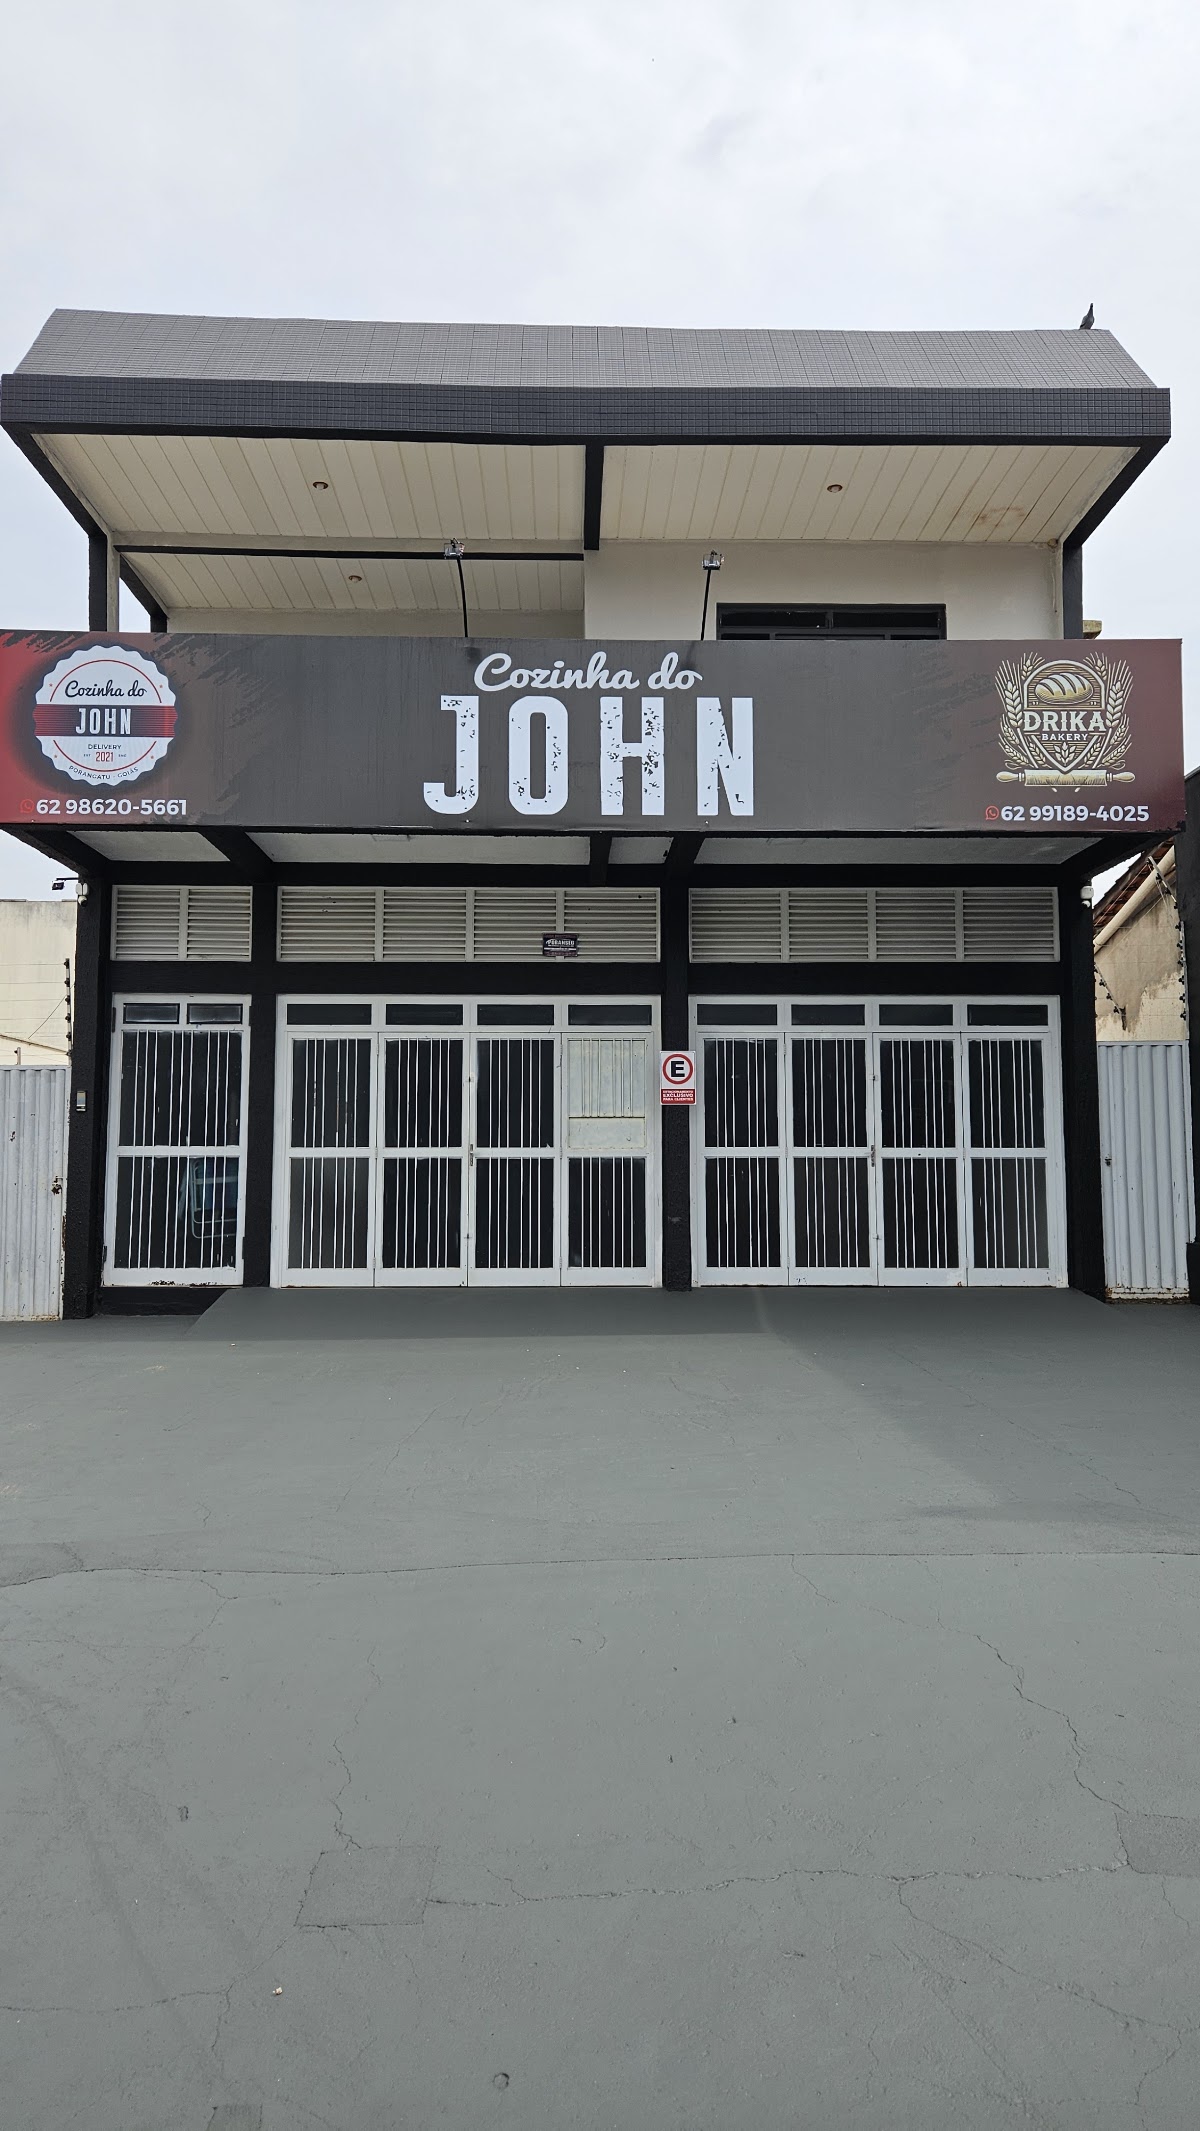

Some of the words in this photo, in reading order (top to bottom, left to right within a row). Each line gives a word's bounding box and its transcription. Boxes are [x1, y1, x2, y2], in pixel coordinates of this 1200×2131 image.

[474, 651, 640, 691] Cozinha
[648, 651, 703, 690] do
[65, 680, 124, 697] Cozinha
[127, 681, 147, 697] do
[76, 708, 131, 734] JOHN
[1023, 711, 1106, 731] DRIKA
[1041, 733, 1088, 741] BAKERY
[95, 751, 114, 762] 2021
[423, 695, 754, 816] JOHN
[68, 764, 111, 780] PORANGATU
[36, 799, 61, 815] 62
[65, 799, 187, 815] 98620-5661
[1001, 805, 1026, 822] 62
[1029, 805, 1150, 822] 99189-4025
[671, 1061, 685, 1077] E
